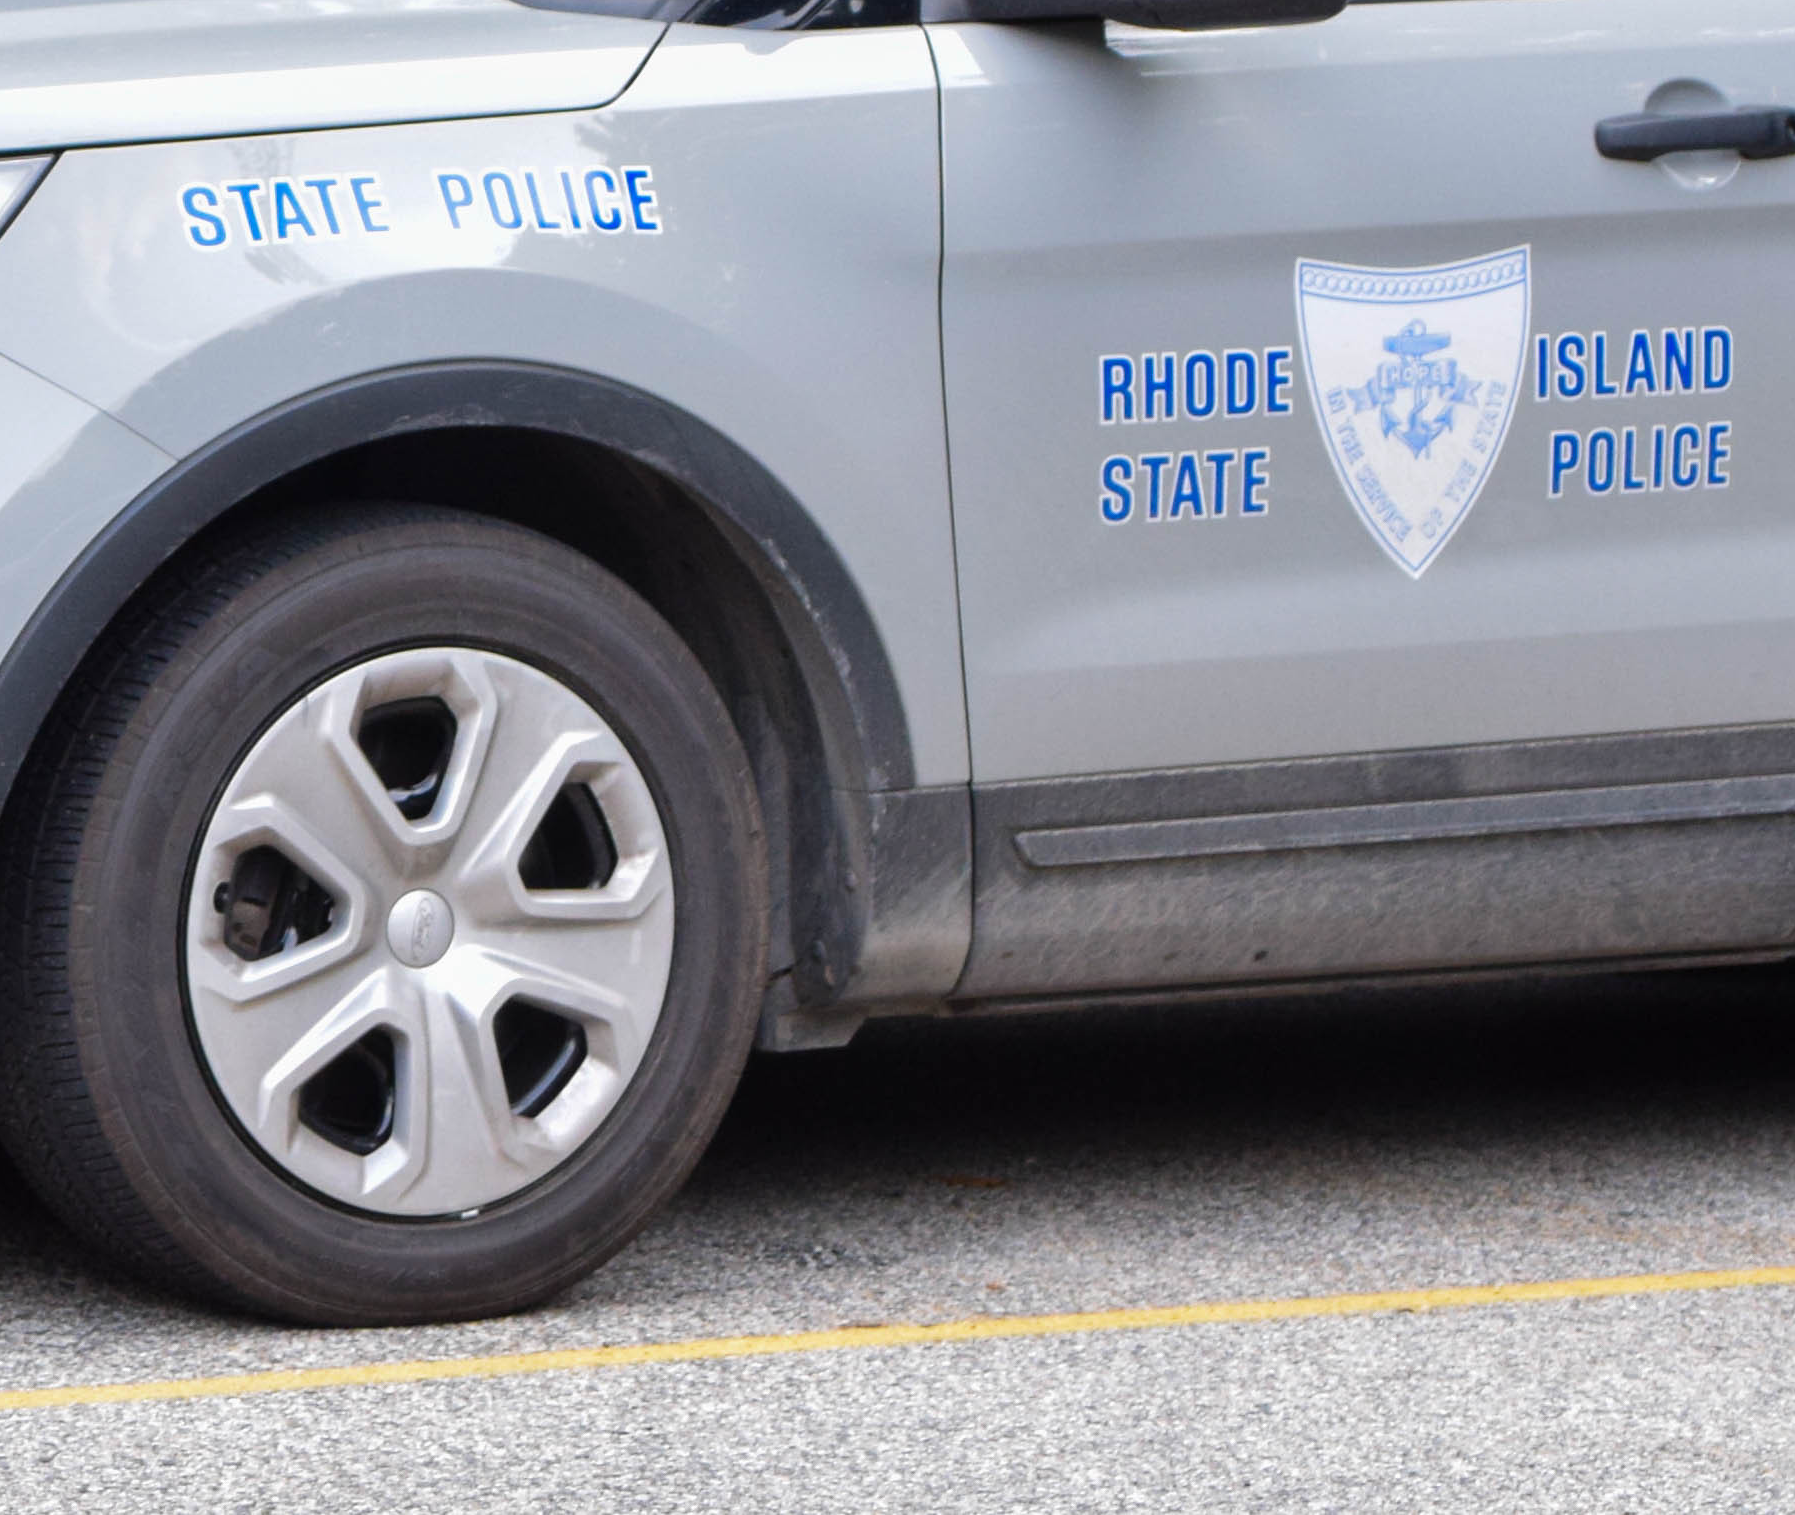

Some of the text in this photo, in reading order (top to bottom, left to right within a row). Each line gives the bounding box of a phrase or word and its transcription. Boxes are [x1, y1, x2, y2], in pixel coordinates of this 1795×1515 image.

[180, 168, 659, 248] STATE POLICE
[1101, 327, 1733, 422] RHODE ISLAND
[1389, 363, 1443, 383] HOPE
[1100, 423, 1732, 523] STATE POLICE
